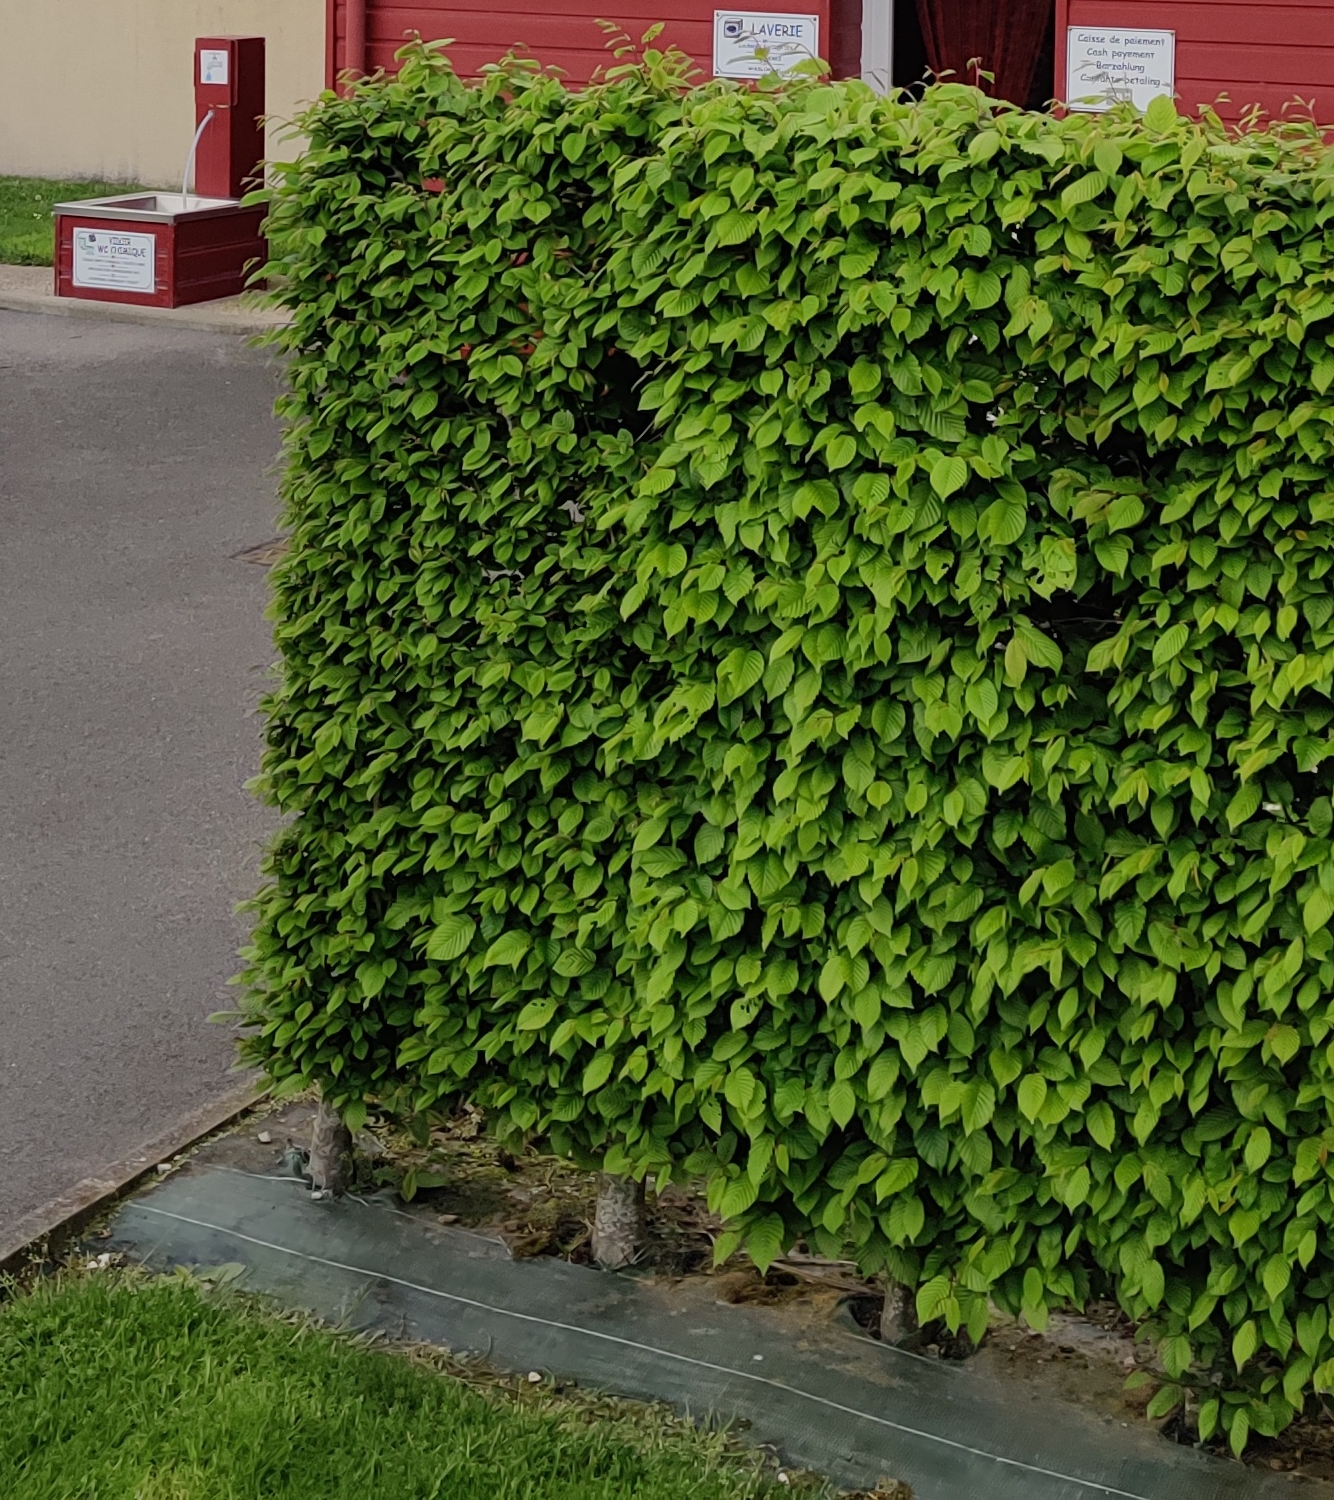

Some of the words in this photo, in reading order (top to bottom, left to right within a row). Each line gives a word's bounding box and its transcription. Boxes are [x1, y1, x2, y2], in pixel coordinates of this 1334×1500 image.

[751, 23, 803, 38] LAVERIE
[1077, 33, 1106, 44] Caisse
[1109, 35, 1120, 44] de
[1124, 36, 1165, 46] paiement
[1086, 47, 1108, 57] Cash
[1111, 50, 1155, 60] payement
[1096, 60, 1145, 73] Barzahlung
